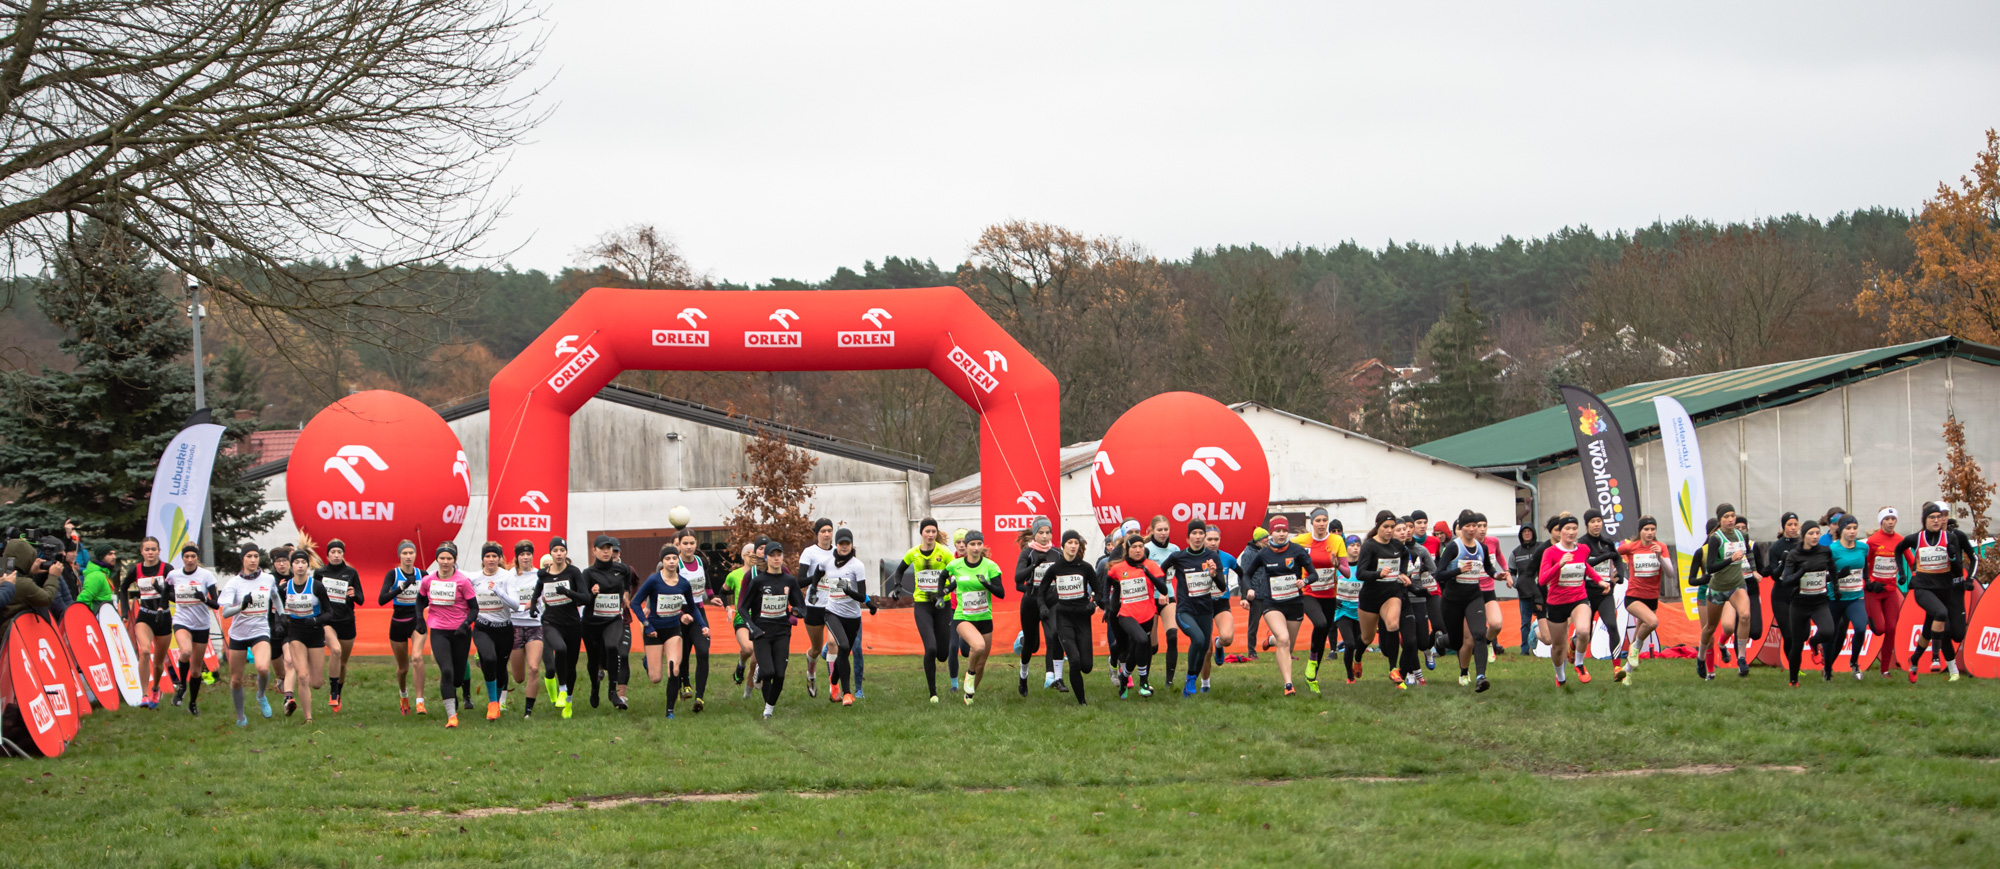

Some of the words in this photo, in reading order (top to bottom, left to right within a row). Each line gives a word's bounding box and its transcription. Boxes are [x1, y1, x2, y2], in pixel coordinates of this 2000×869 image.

[655, 332, 705, 345] ORLEN
[748, 334, 798, 345] ORLEN
[841, 333, 891, 345] ORLEN
[553, 349, 595, 388] ORLEN
[952, 351, 994, 390] ORLEN
[169, 443, 188, 496] Lubuskie
[317, 500, 394, 521] ORLEN
[442, 504, 467, 524] ORL
[1171, 501, 1246, 522] ORLEN
[500, 516, 547, 529] ORLEN
[997, 517, 1034, 528] ORLE
[1058, 583, 1082, 591] BRUDNY
[93, 668, 111, 689] ORLEN
[32, 699, 52, 728] ORLEN
